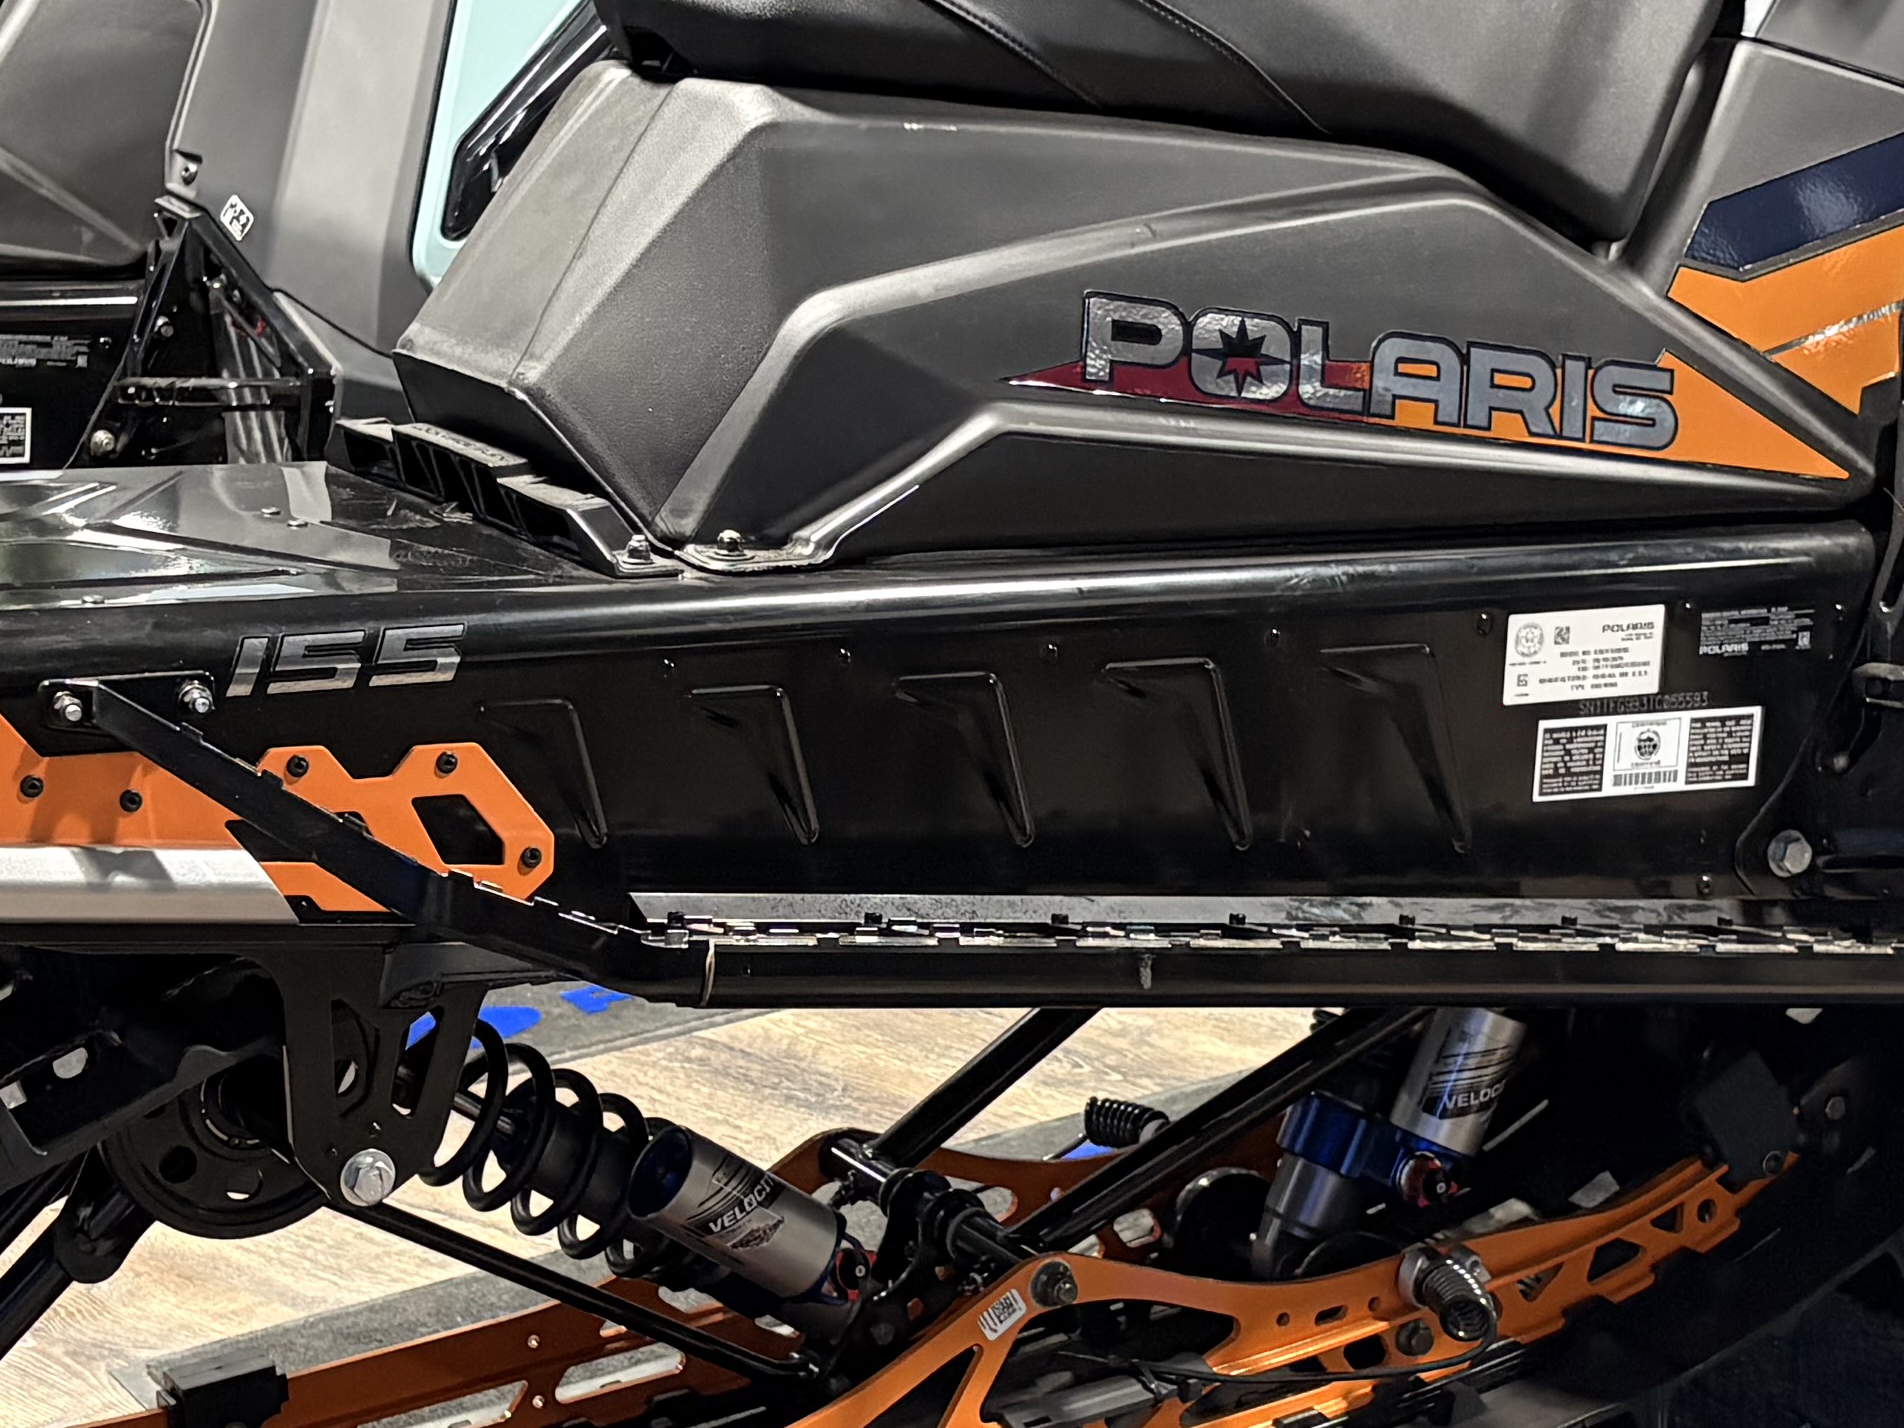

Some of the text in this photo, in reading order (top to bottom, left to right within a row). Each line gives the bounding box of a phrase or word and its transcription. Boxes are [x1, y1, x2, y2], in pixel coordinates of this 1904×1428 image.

[1080, 288, 1679, 452] POLARIS
[224, 621, 467, 699] 155
[1602, 621, 1656, 634] POLARIS
